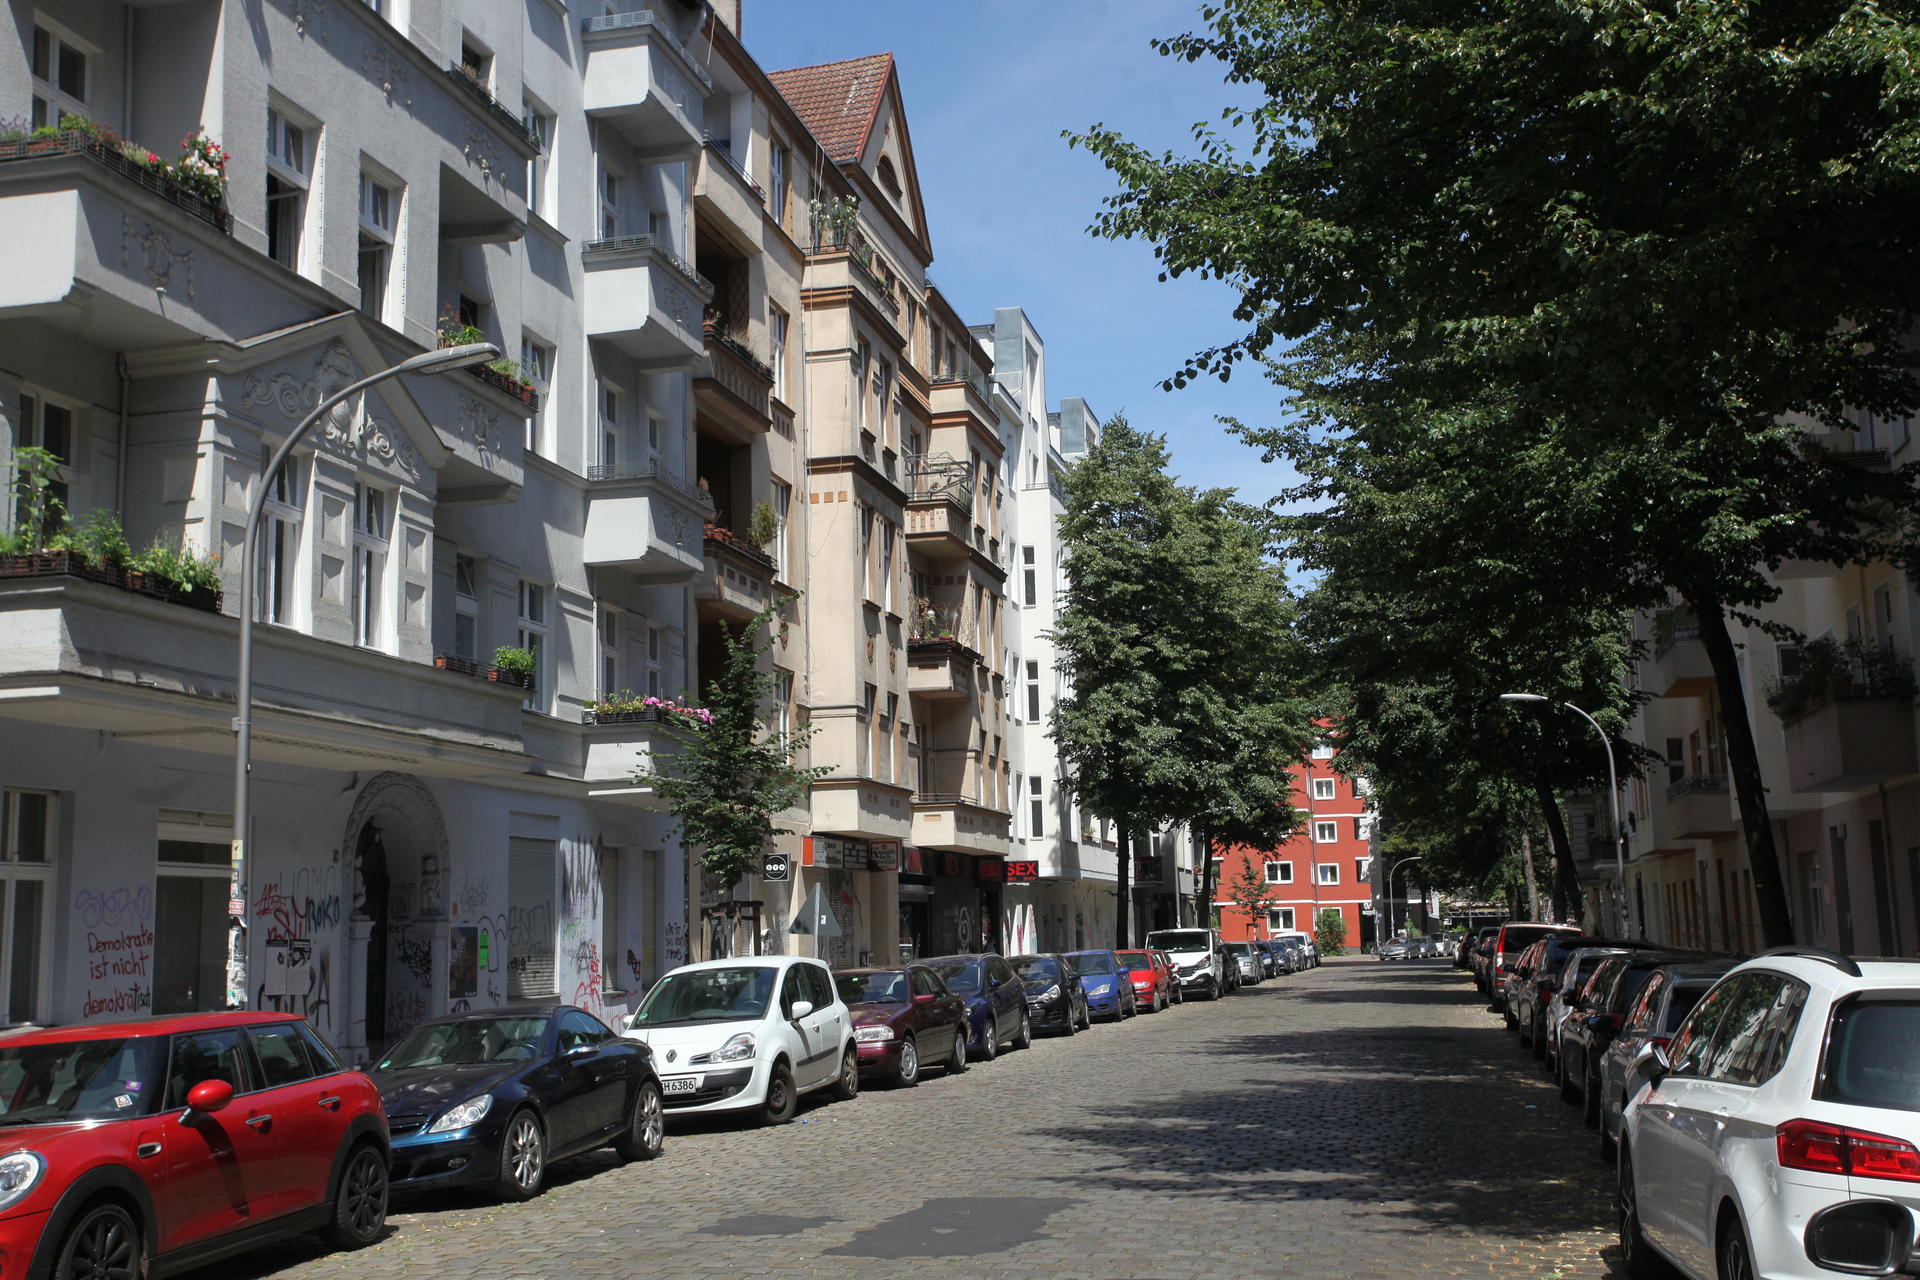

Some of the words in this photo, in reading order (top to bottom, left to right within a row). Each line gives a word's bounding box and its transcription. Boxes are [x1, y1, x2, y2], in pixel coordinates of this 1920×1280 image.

[1007, 863, 1037, 876] SEX
[87, 922, 154, 954] Demokratie
[90, 955, 109, 980] ist
[112, 950, 150, 977] nicht
[671, 1079, 694, 1091] 6386
